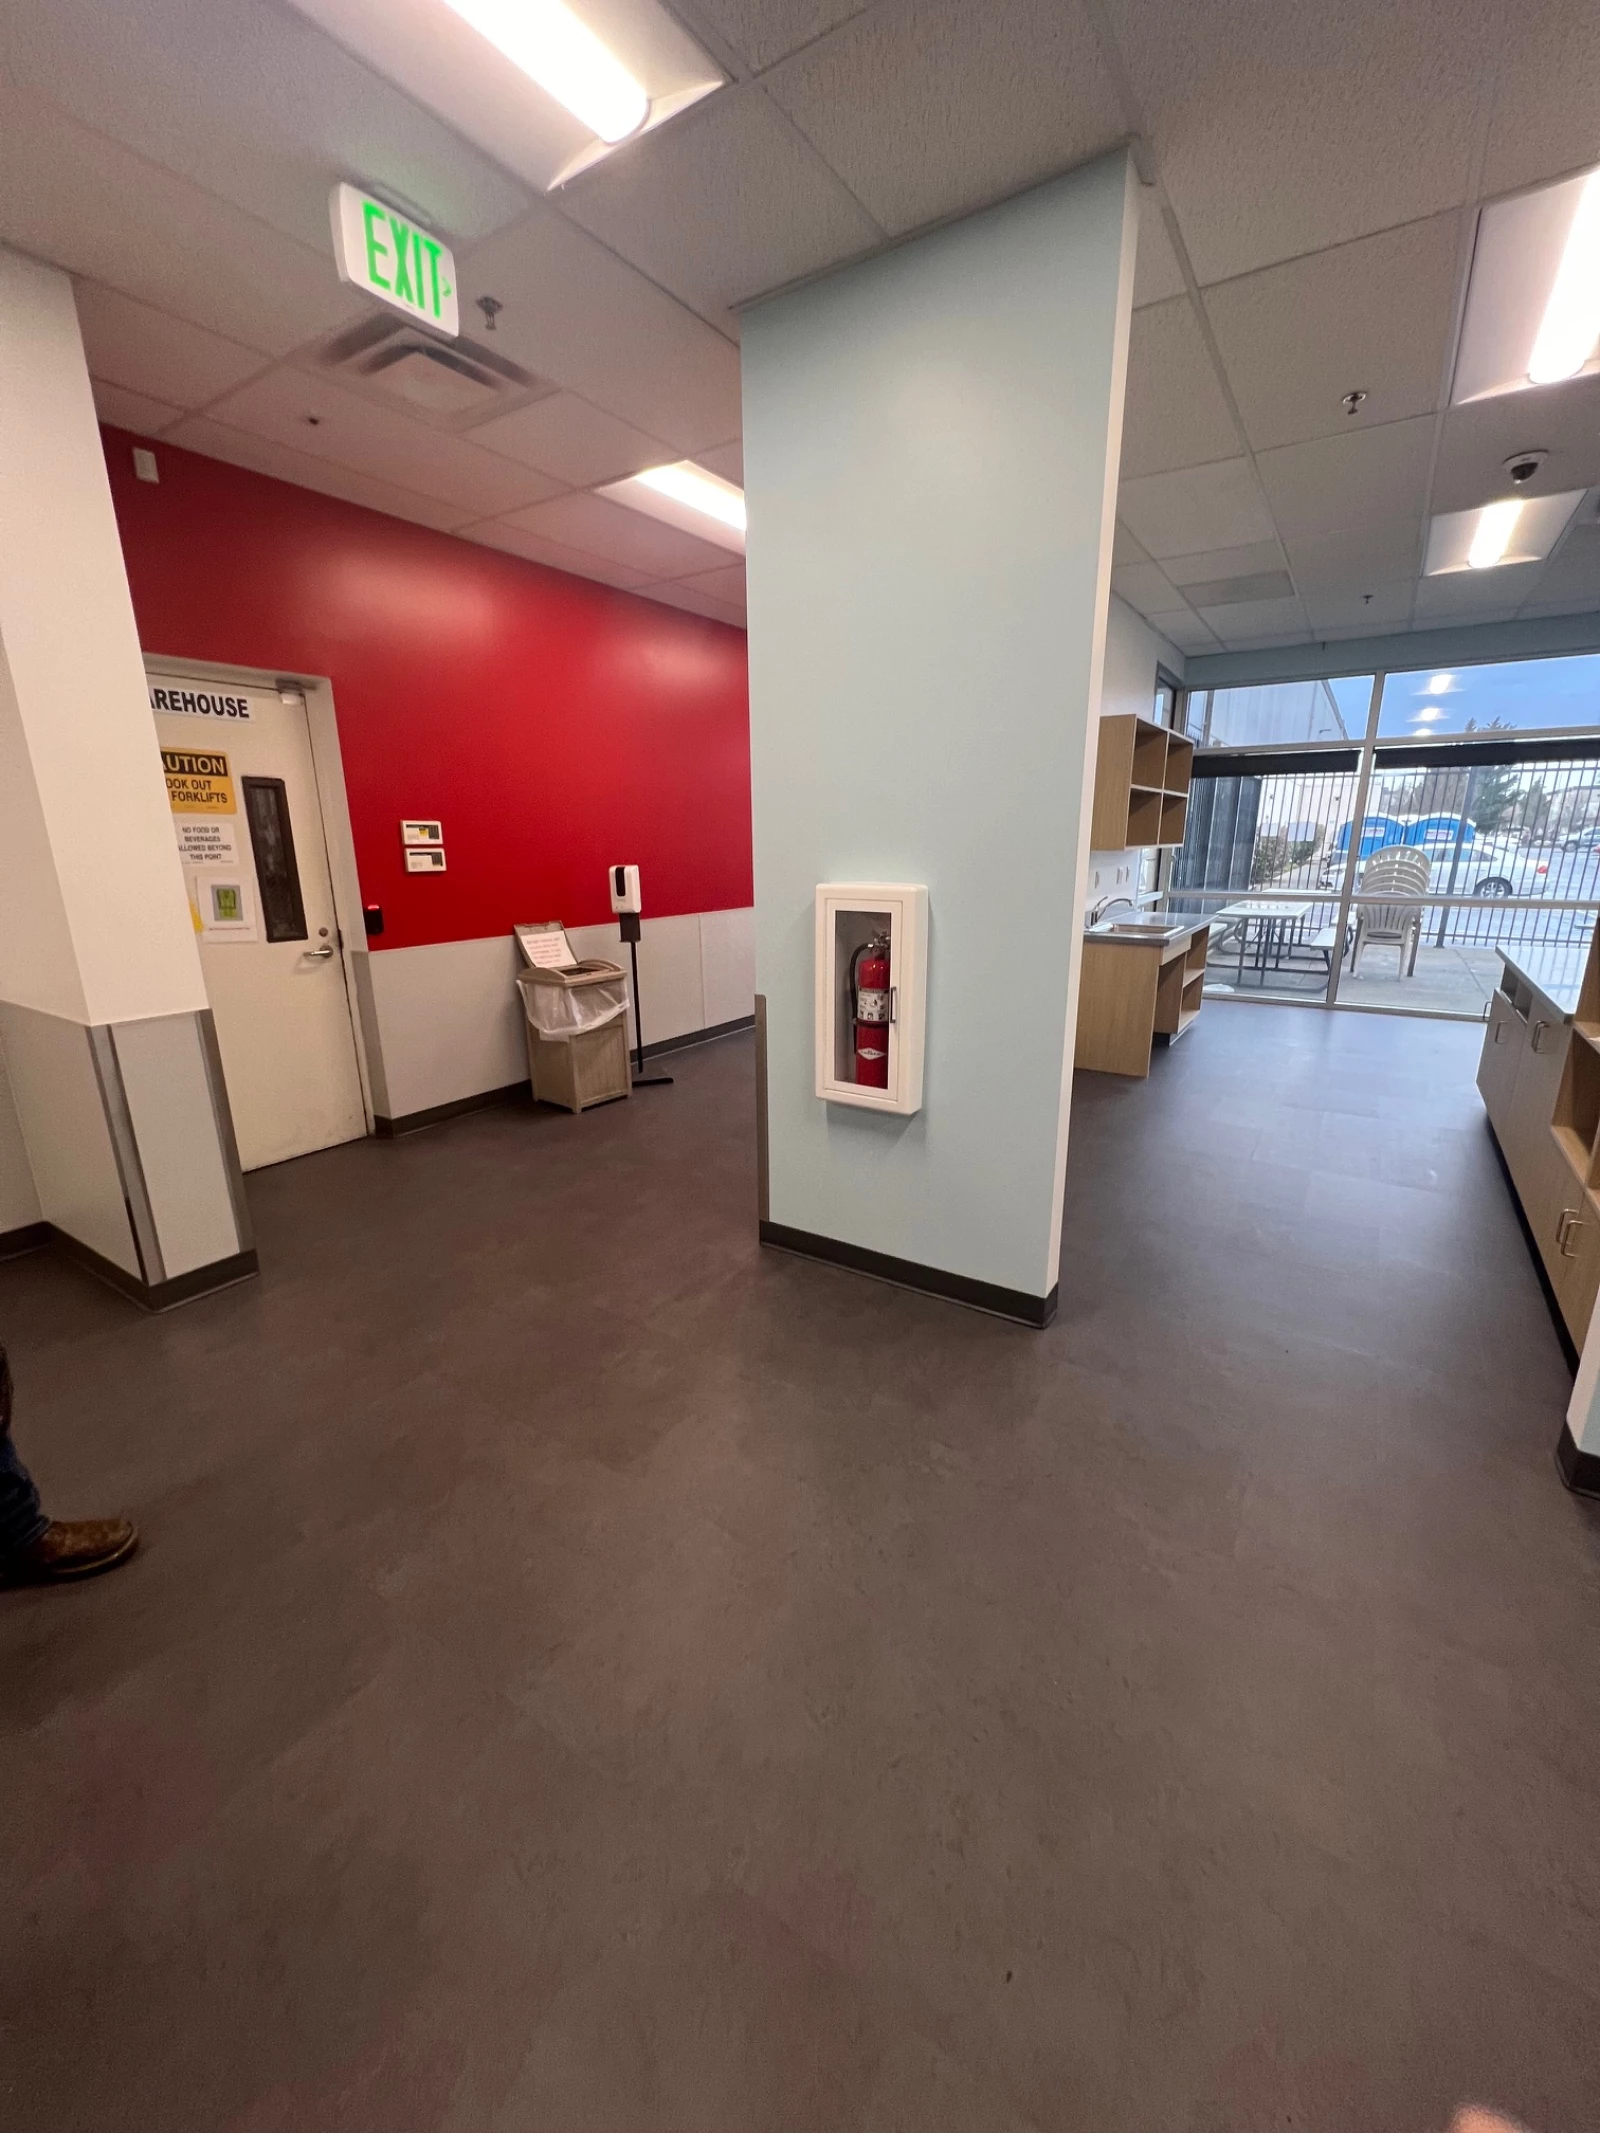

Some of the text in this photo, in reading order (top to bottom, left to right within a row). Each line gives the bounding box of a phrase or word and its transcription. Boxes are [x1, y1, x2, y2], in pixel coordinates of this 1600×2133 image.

[362, 200, 443, 319] EXIT
[191, 779, 212, 791] OUT
[171, 790, 228, 804] FORKLIFTS
[182, 826, 220, 834] NO FOOD OR
[184, 835, 221, 843] BEVERAGES
[207, 844, 232, 852] BEYOND
[190, 853, 222, 861] THIS POINT
